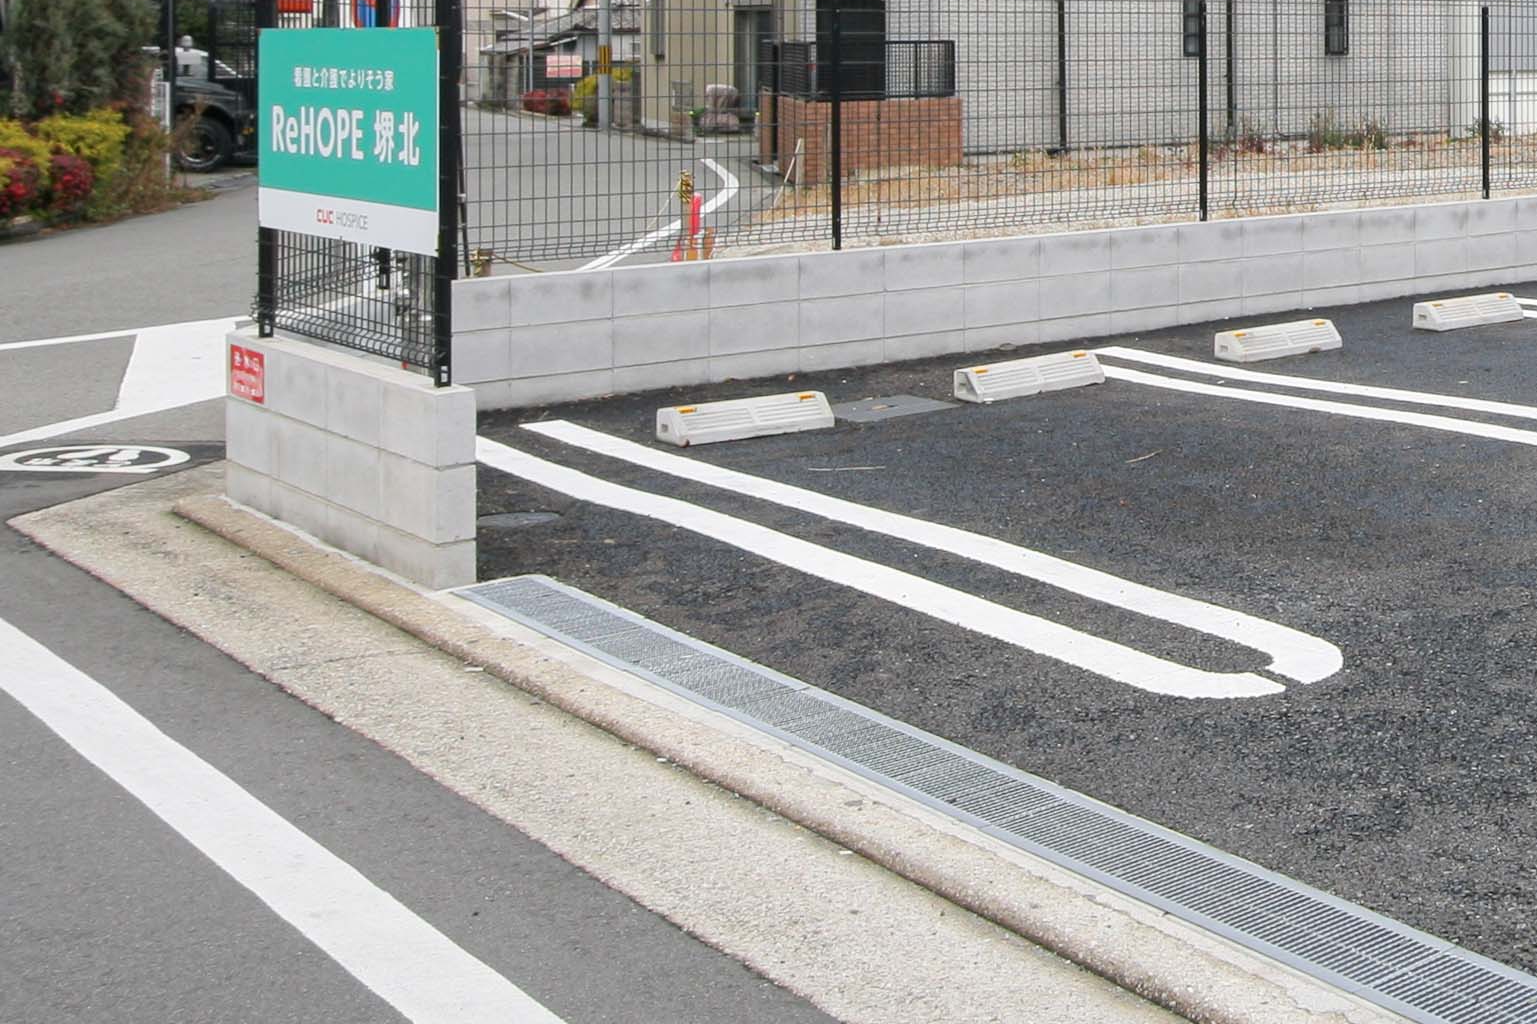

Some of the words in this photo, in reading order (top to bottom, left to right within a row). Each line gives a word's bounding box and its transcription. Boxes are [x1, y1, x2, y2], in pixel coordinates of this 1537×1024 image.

[272, 105, 365, 160] ReHOPE
[374, 110, 420, 166] 堺北
[335, 211, 369, 231] HOSPICE
